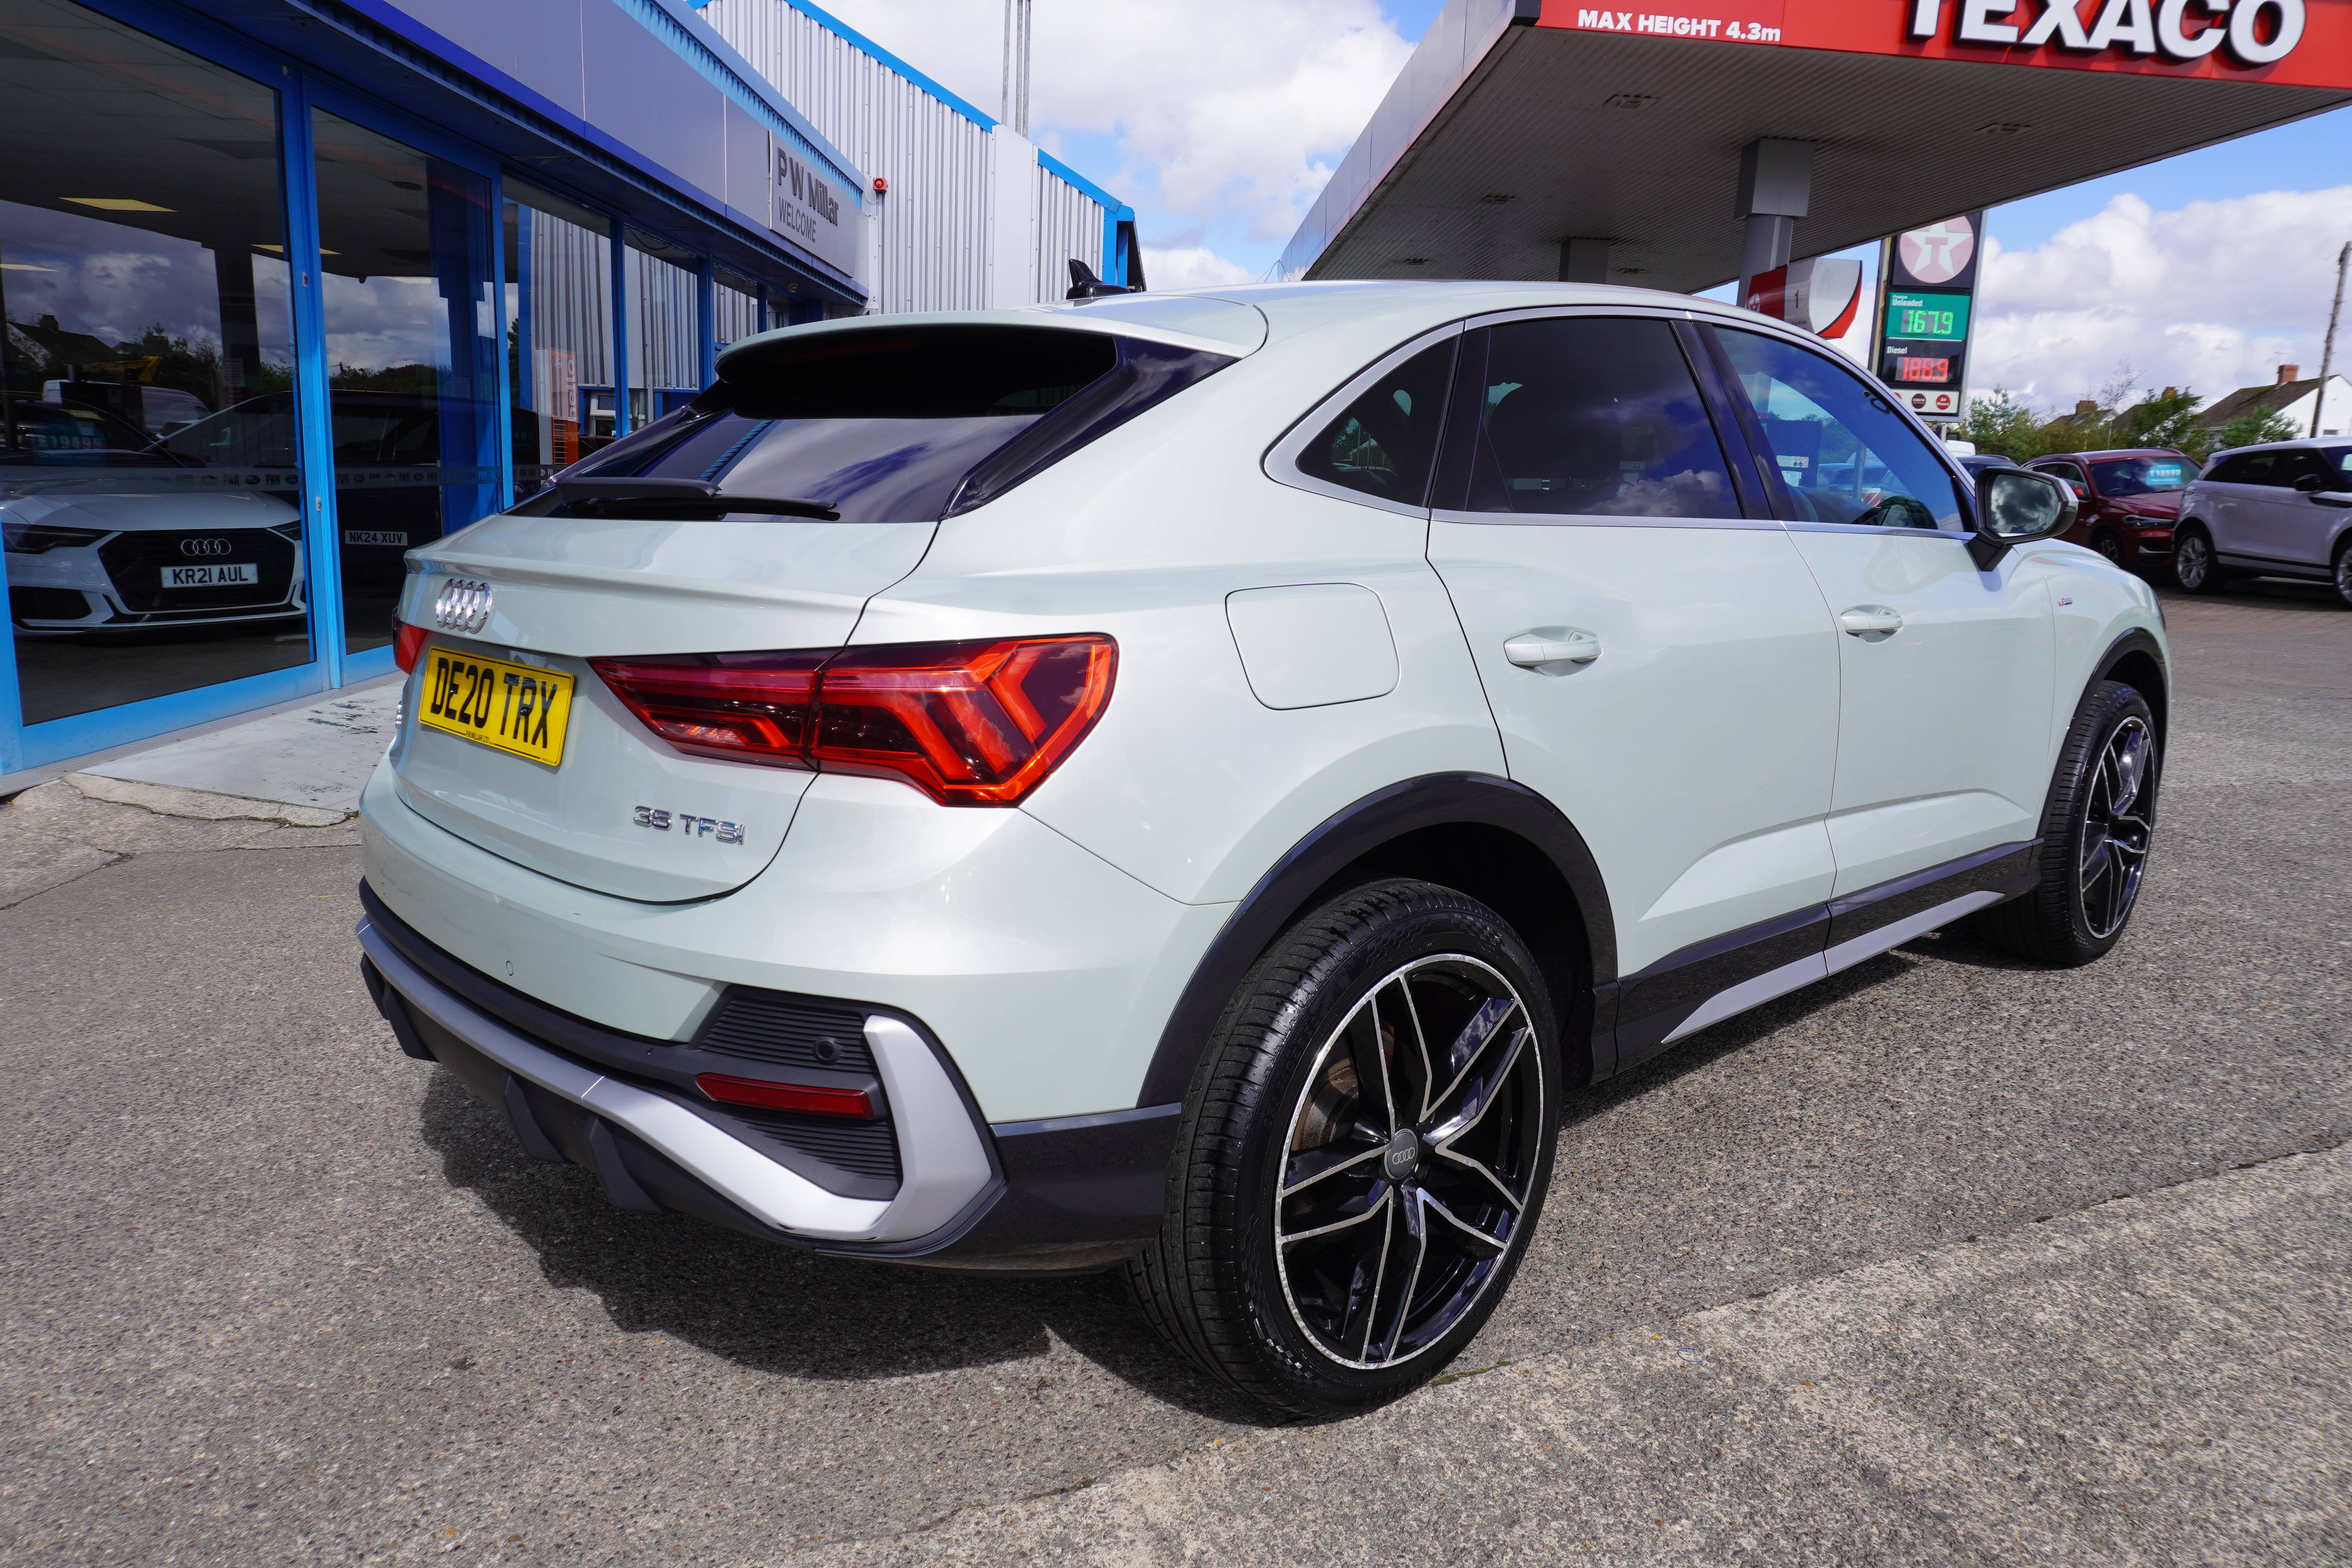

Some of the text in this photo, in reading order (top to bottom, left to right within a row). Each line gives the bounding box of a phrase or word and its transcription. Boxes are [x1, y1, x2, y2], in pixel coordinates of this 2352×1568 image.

[1578, 9, 1781, 42] MAX HEIGHT 4.3m
[778, 147, 839, 226] P W Millar
[779, 196, 817, 243] WELCOME
[1795, 290, 1799, 309] 1
[1893, 298, 1923, 307] Unleaded
[1907, 310, 1954, 335] 167.9
[1887, 346, 1908, 354] Diesel
[1902, 357, 1949, 381] 188.9
[566, 359, 577, 422] hello
[349, 532, 403, 544] NK24 XUV
[172, 565, 249, 584] KR21 AUL
[430, 657, 558, 749] DE20 TRX
[633, 805, 746, 845] 35 TFSI
